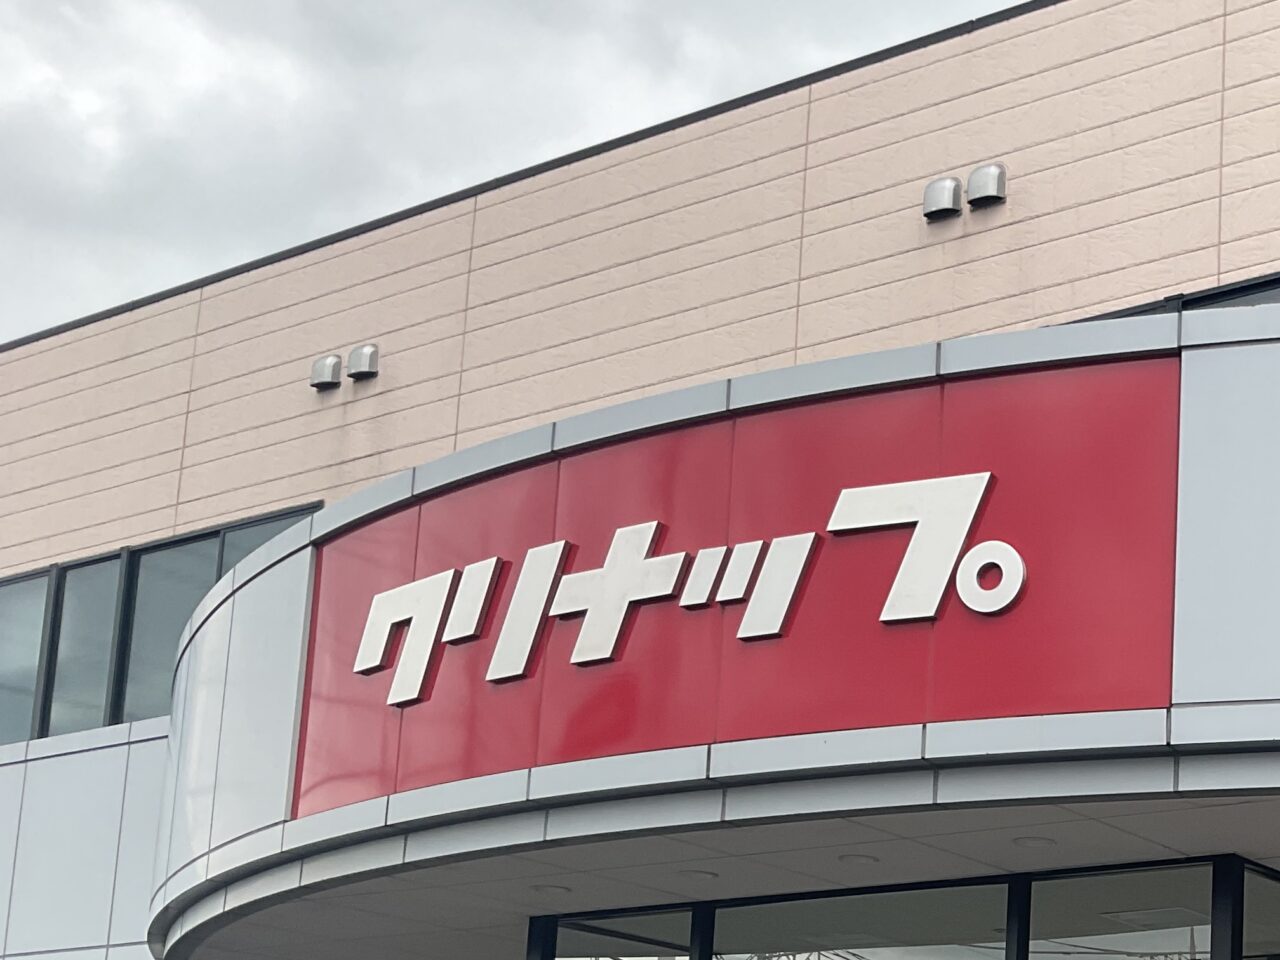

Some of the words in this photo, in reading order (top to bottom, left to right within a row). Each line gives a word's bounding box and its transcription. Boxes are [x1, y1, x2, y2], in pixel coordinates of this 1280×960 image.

[353, 471, 1027, 706] クリナップ
